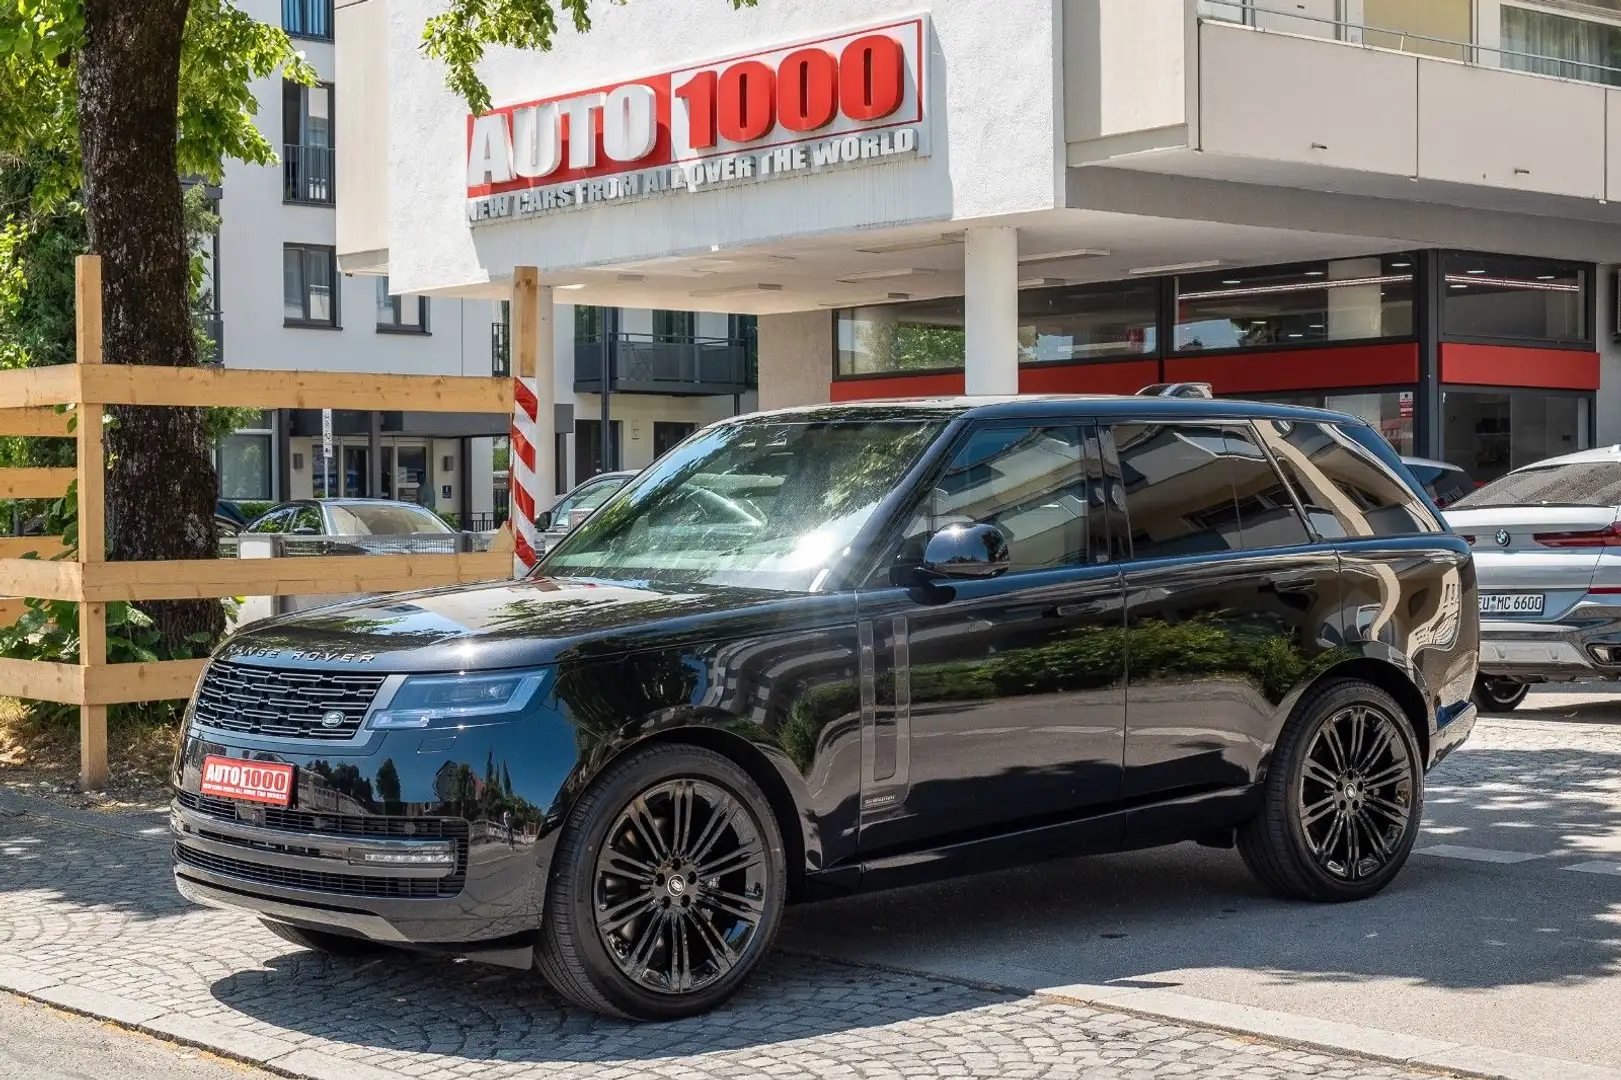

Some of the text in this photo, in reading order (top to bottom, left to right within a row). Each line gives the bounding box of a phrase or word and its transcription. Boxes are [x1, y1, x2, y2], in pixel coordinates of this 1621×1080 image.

[467, 34, 904, 187] AUTO 1000
[468, 196, 509, 221] NEW
[518, 186, 573, 214] CARS
[575, 175, 638, 204] FROM
[690, 155, 756, 186] OVER
[760, 145, 807, 175] THE
[812, 128, 918, 167] WORLD
[1497, 596, 1511, 610] MC
[1513, 596, 1542, 610] 6600
[225, 643, 375, 664] RANGE ROVER
[206, 764, 239, 785] AUTO
[243, 768, 286, 791] 1000
